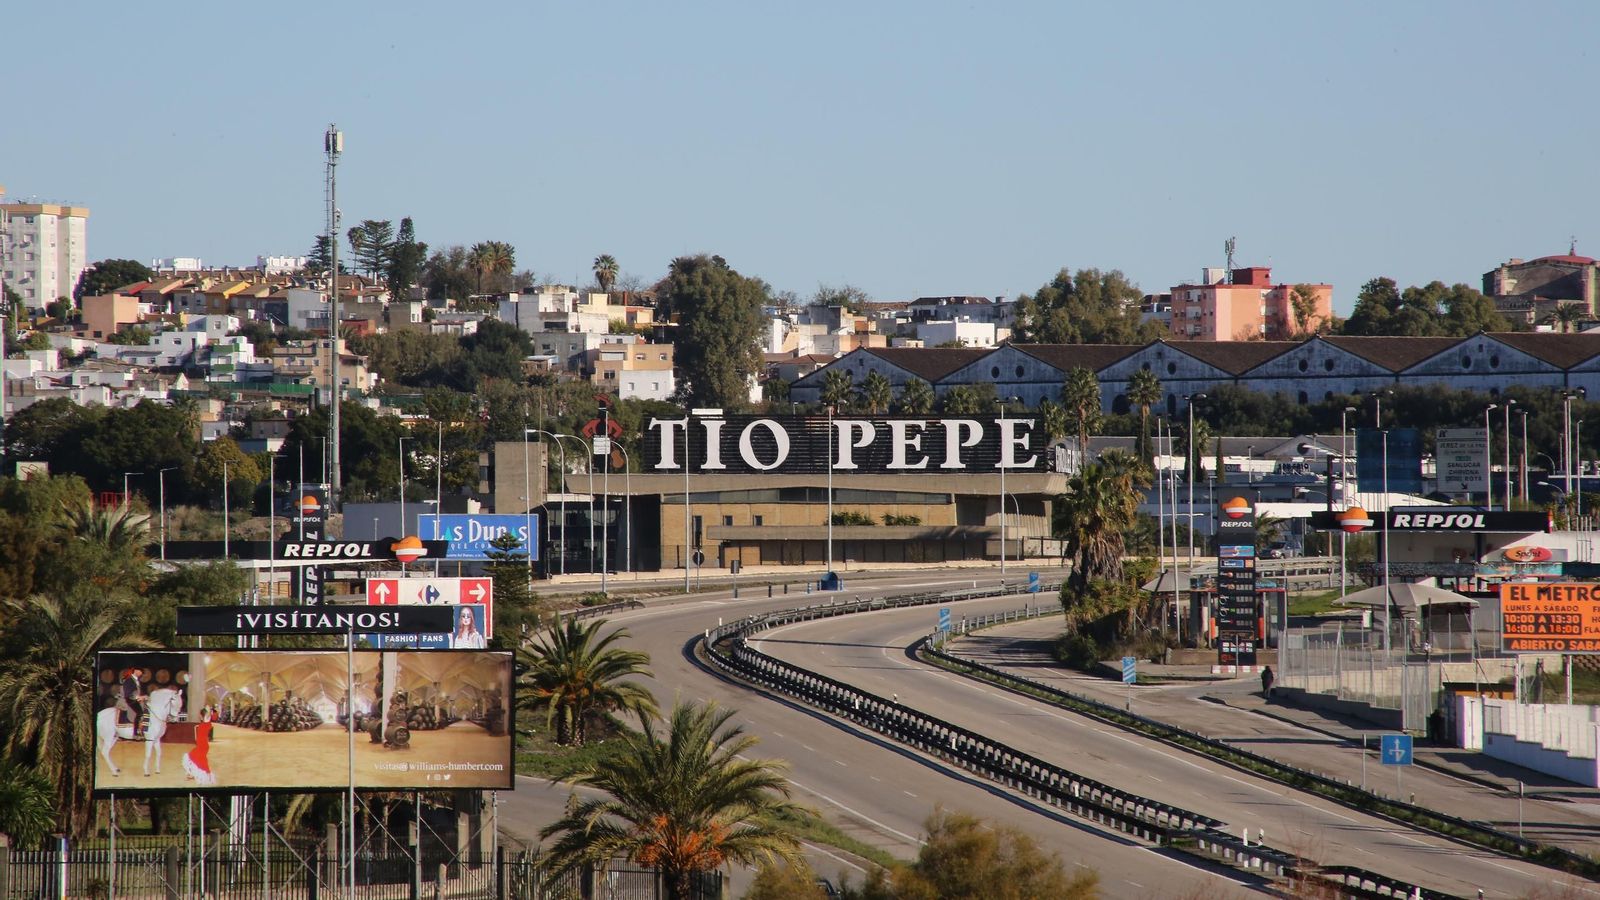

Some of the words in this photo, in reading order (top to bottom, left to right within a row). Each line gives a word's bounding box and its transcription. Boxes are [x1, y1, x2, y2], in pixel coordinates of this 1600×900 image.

[832, 418, 1038, 469] PEPE
[1393, 514, 1486, 528] REPSOL
[284, 543, 372, 557] REPSOL
[1510, 586, 1530, 601] EL
[236, 611, 400, 629] ¡VISÍTANOS!
[1504, 614, 1535, 623] 10:00
[1538, 615, 1547, 623] A
[1550, 614, 1580, 624] 13:30
[1505, 624, 1535, 633] 16:00
[1538, 625, 1547, 633] A
[1511, 640, 1566, 650] ABIERTO
